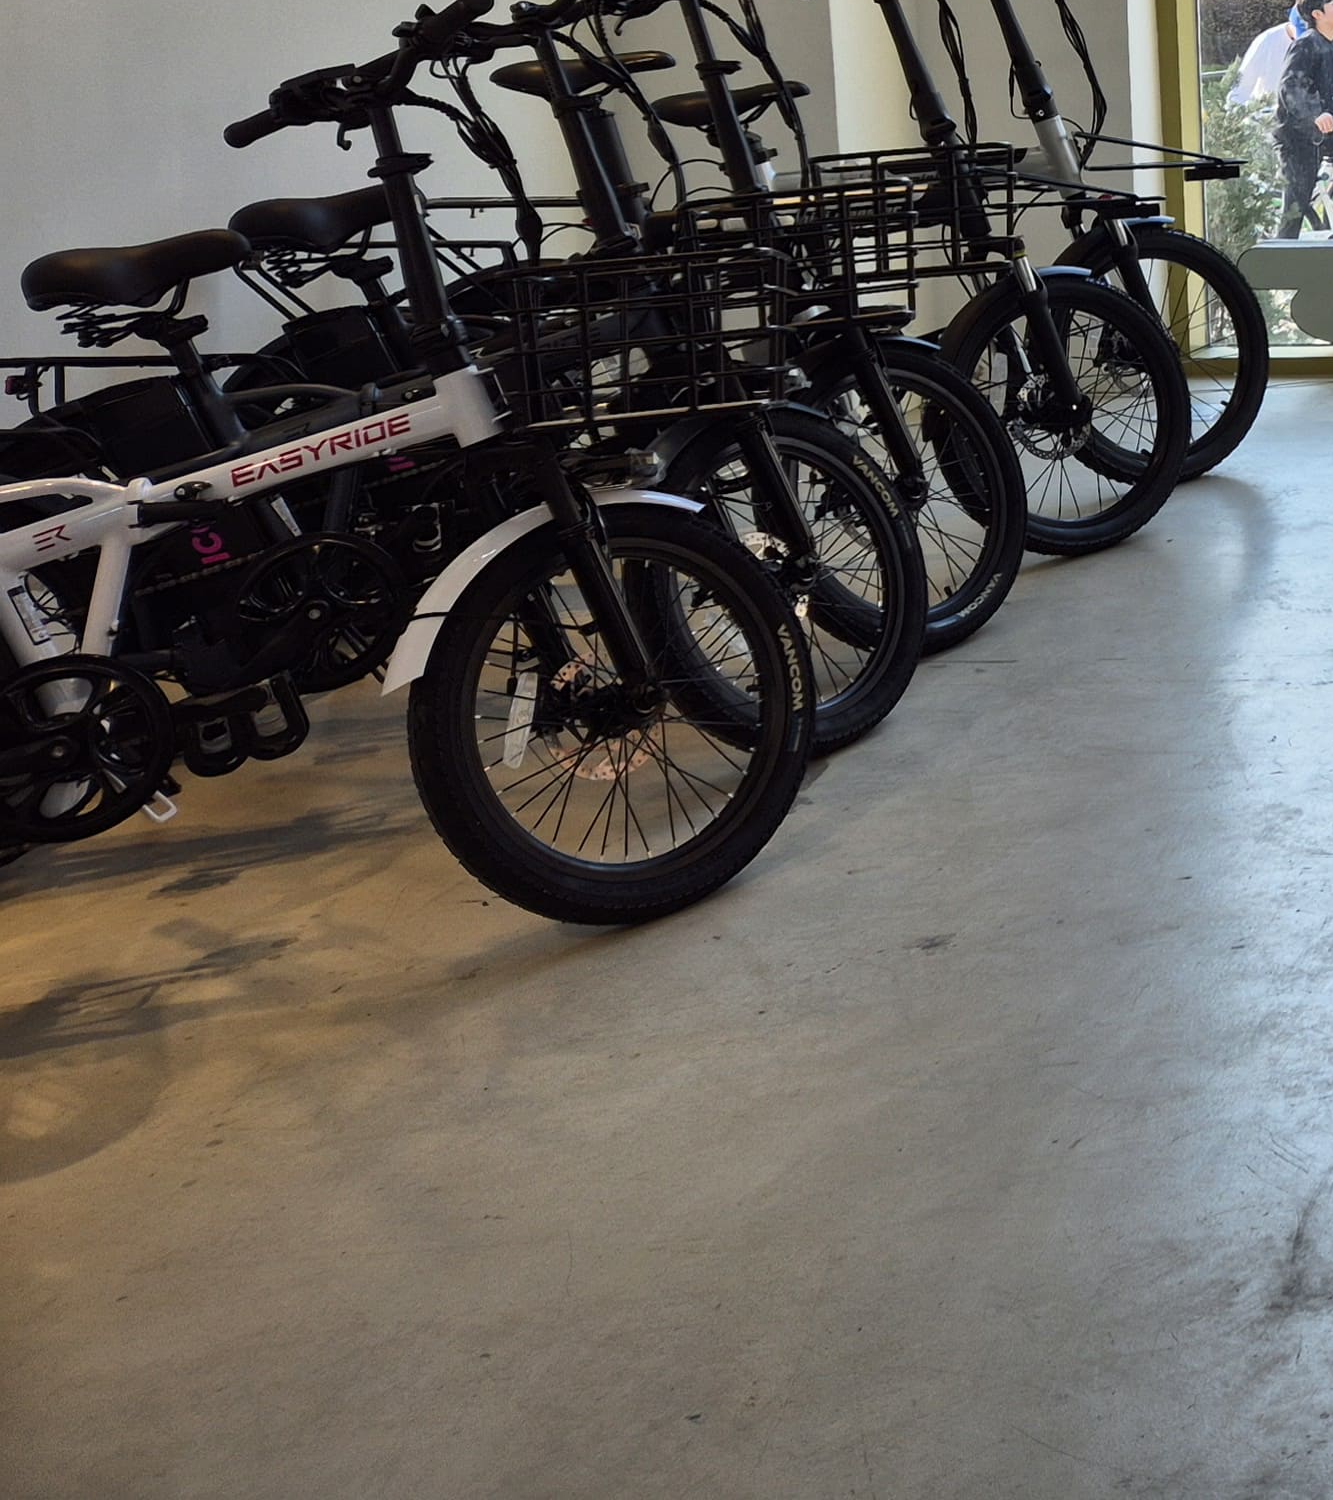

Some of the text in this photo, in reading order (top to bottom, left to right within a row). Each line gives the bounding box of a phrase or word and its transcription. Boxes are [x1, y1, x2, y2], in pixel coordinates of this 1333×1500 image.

[231, 413, 412, 488] EASYRIDE
[850, 453, 900, 518] VANCOM
[956, 572, 1004, 618] VANCOM
[778, 623, 803, 712] VANCOM
